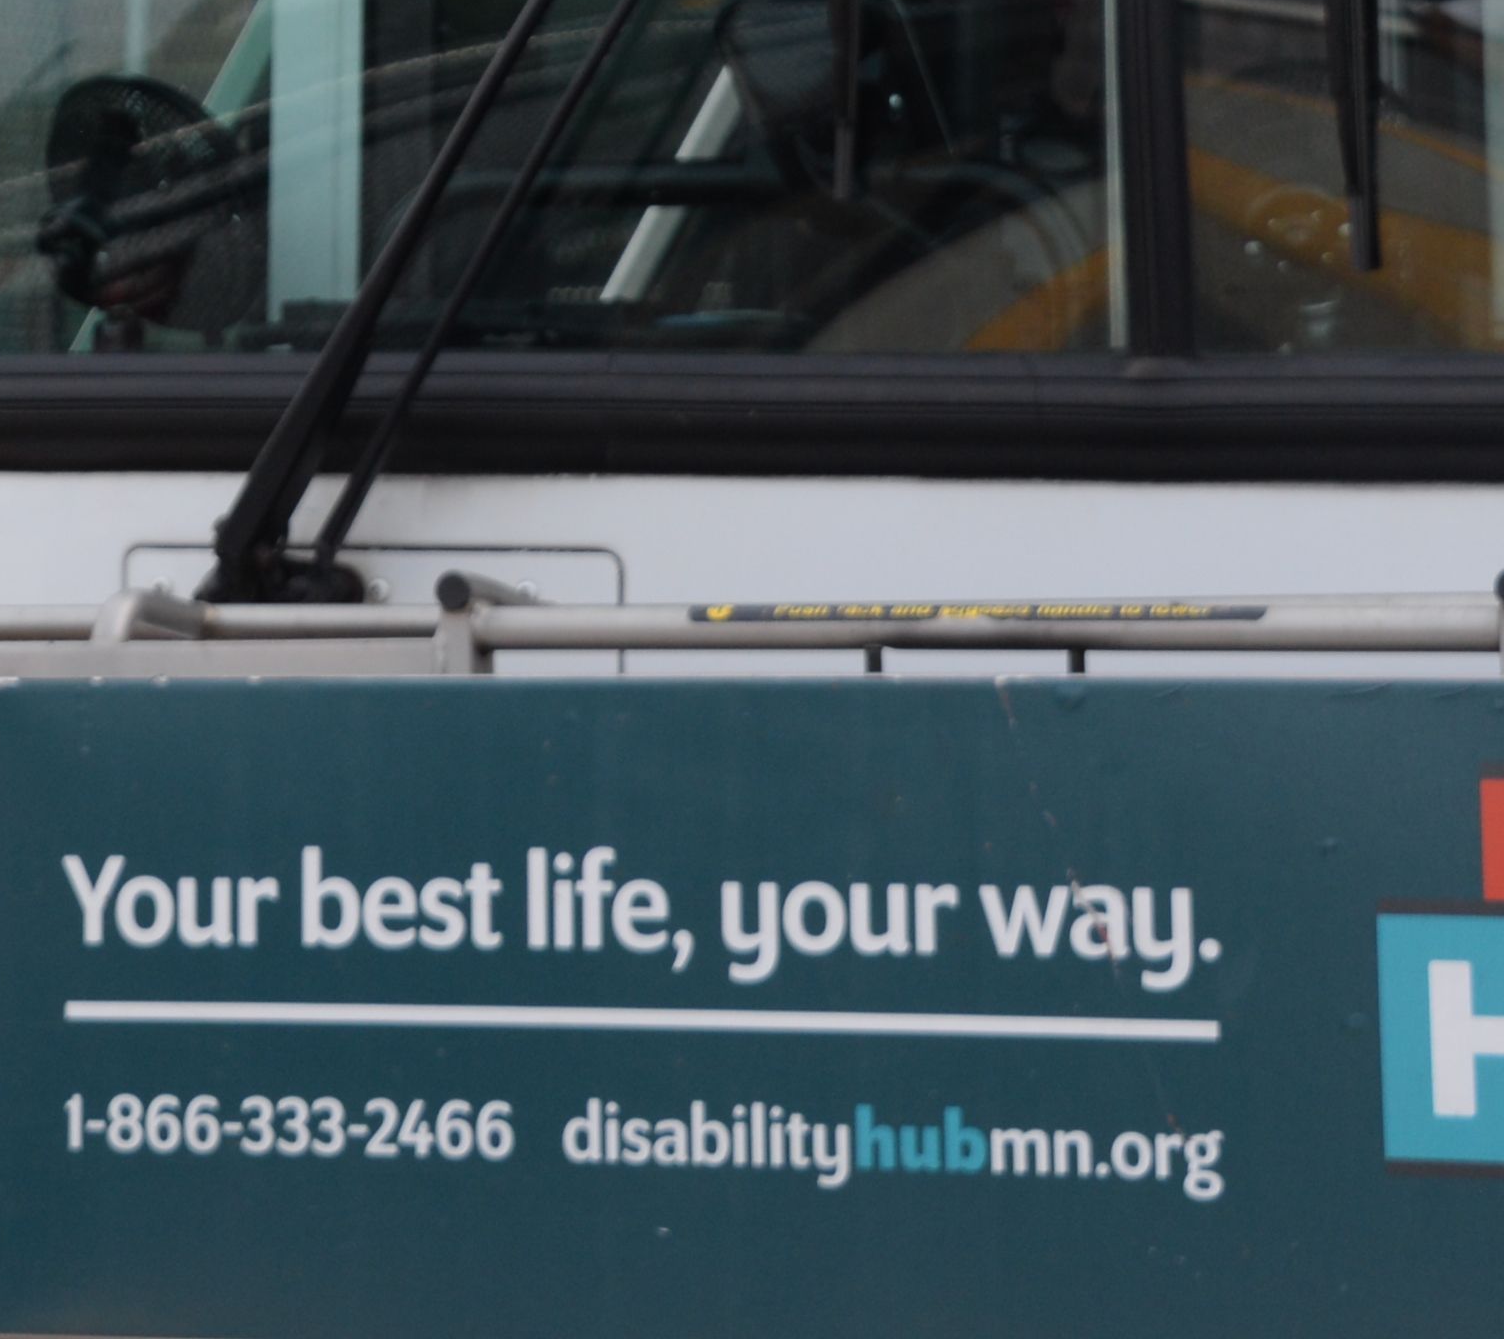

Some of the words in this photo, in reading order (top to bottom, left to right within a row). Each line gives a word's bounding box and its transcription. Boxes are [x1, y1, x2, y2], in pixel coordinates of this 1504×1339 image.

[63, 854, 278, 947] Your
[301, 846, 502, 949] best
[527, 846, 694, 971] life,
[721, 880, 958, 983] your
[980, 885, 1222, 991] way.
[65, 1093, 514, 1159] 1-866-333-2466
[562, 1097, 1224, 1200] disabilityhubmn.org
